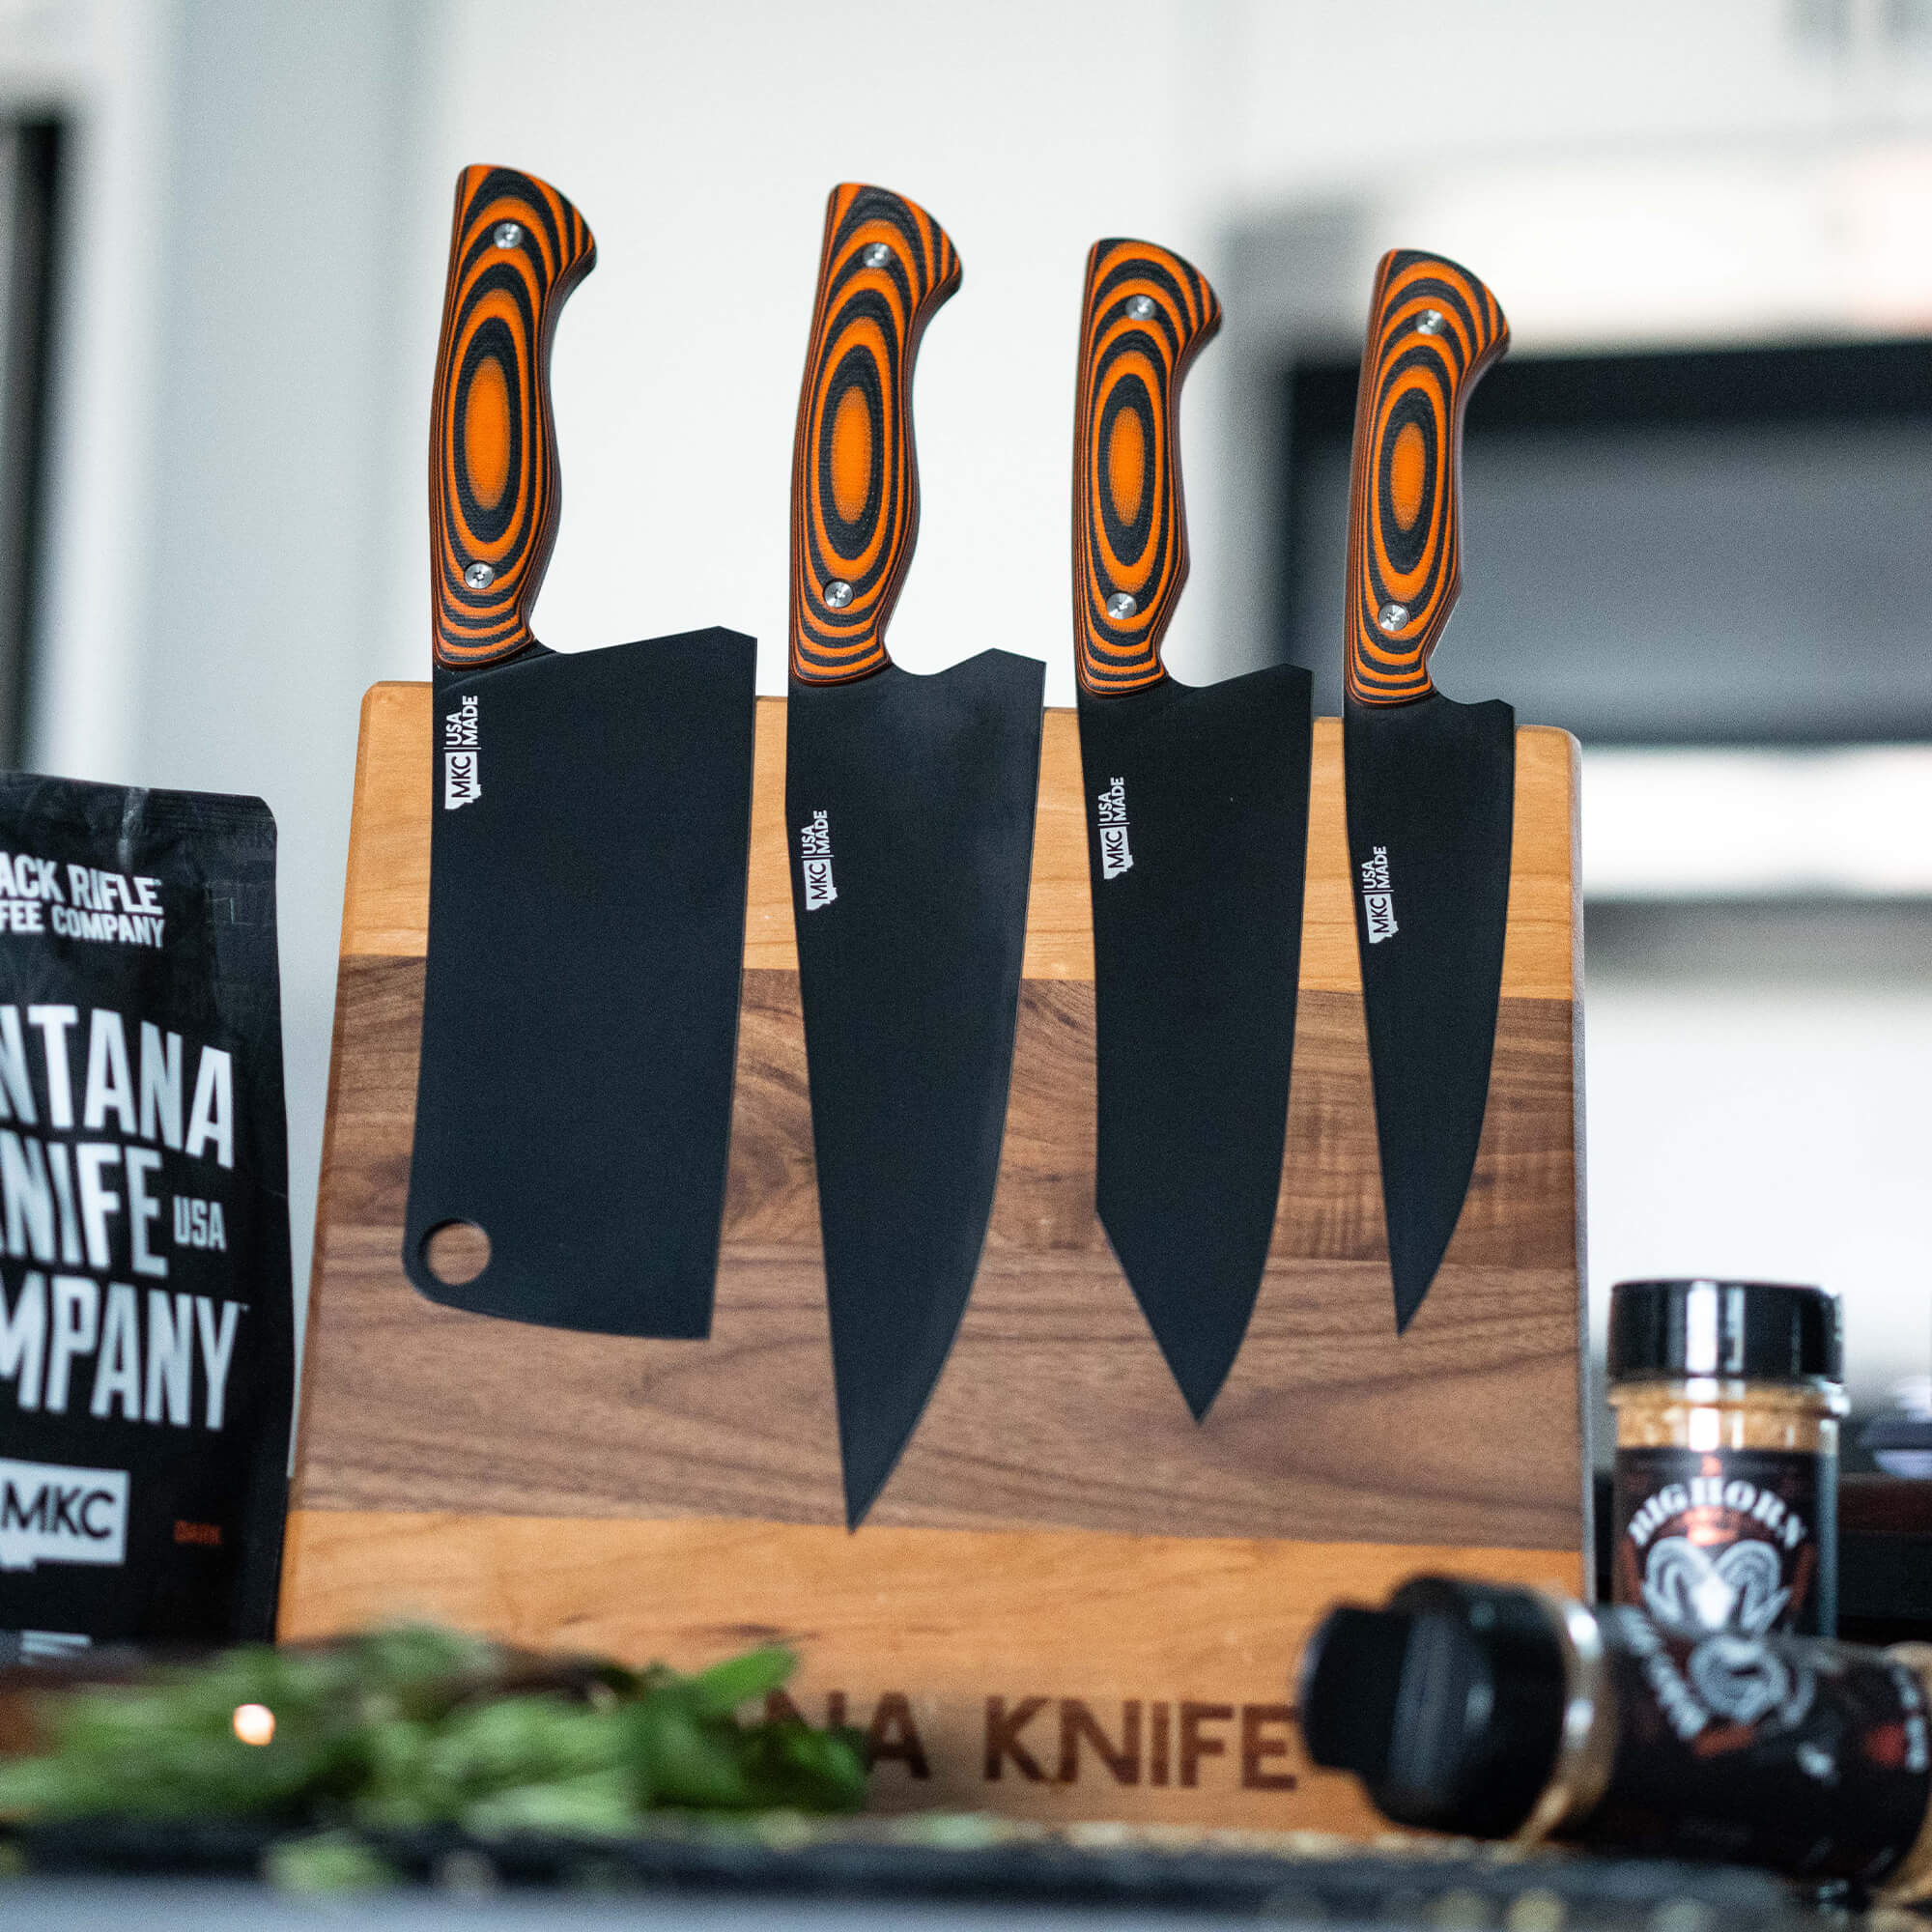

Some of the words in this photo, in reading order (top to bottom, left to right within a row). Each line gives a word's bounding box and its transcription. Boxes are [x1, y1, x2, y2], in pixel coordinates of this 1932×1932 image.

[445, 712, 462, 745] USA
[462, 696, 478, 745] MADE
[451, 756, 471, 798] MKC
[1098, 792, 1113, 822] USA
[1110, 777, 1127, 821] MADE
[801, 824, 816, 854] USA
[813, 810, 831, 854] MADE
[1105, 831, 1125, 868] MKC
[809, 863, 828, 899] MKC
[1361, 860, 1377, 889] USA
[1373, 846, 1391, 889] MADE
[67, 864, 163, 916] RIFLE
[50, 904, 164, 949] COMPANY
[1369, 897, 1389, 933] MKC
[173, 1195, 227, 1251] USA
[1, 1482, 115, 1540] MKC
[983, 1694, 1298, 1791] KNIFE
